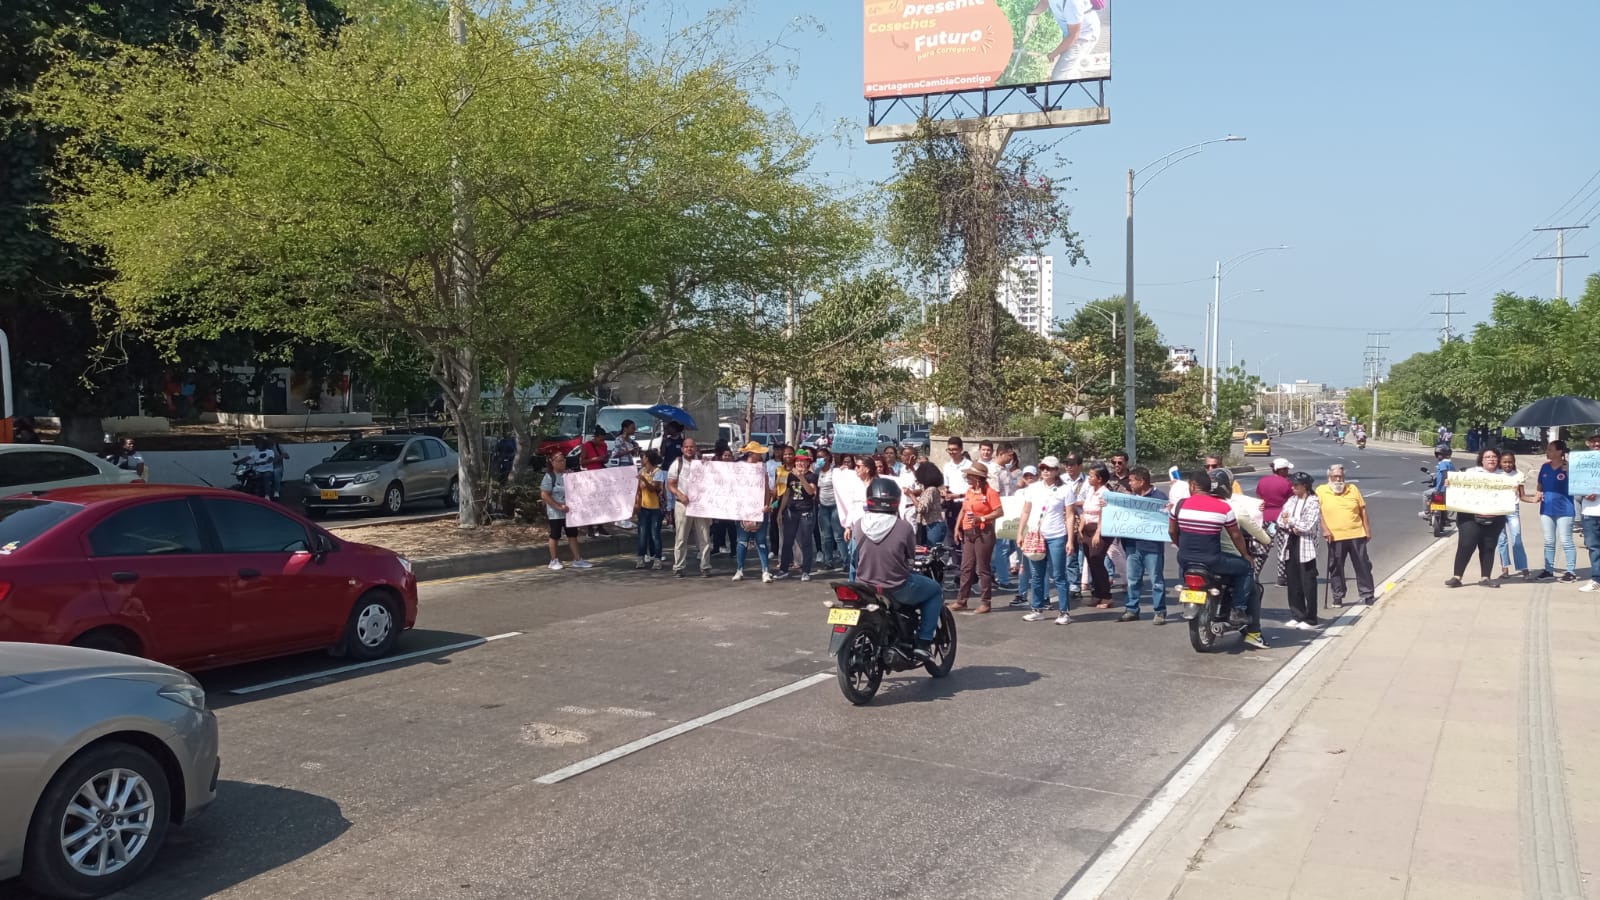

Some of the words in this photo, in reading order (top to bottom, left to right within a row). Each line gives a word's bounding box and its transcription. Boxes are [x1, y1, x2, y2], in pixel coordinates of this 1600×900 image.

[868, 19, 937, 33] Cosechas
[914, 30, 982, 52] Futuro
[866, 75, 991, 92] #CartagenaCambiaContigo
[1111, 523, 1163, 535] NEGOCIA
